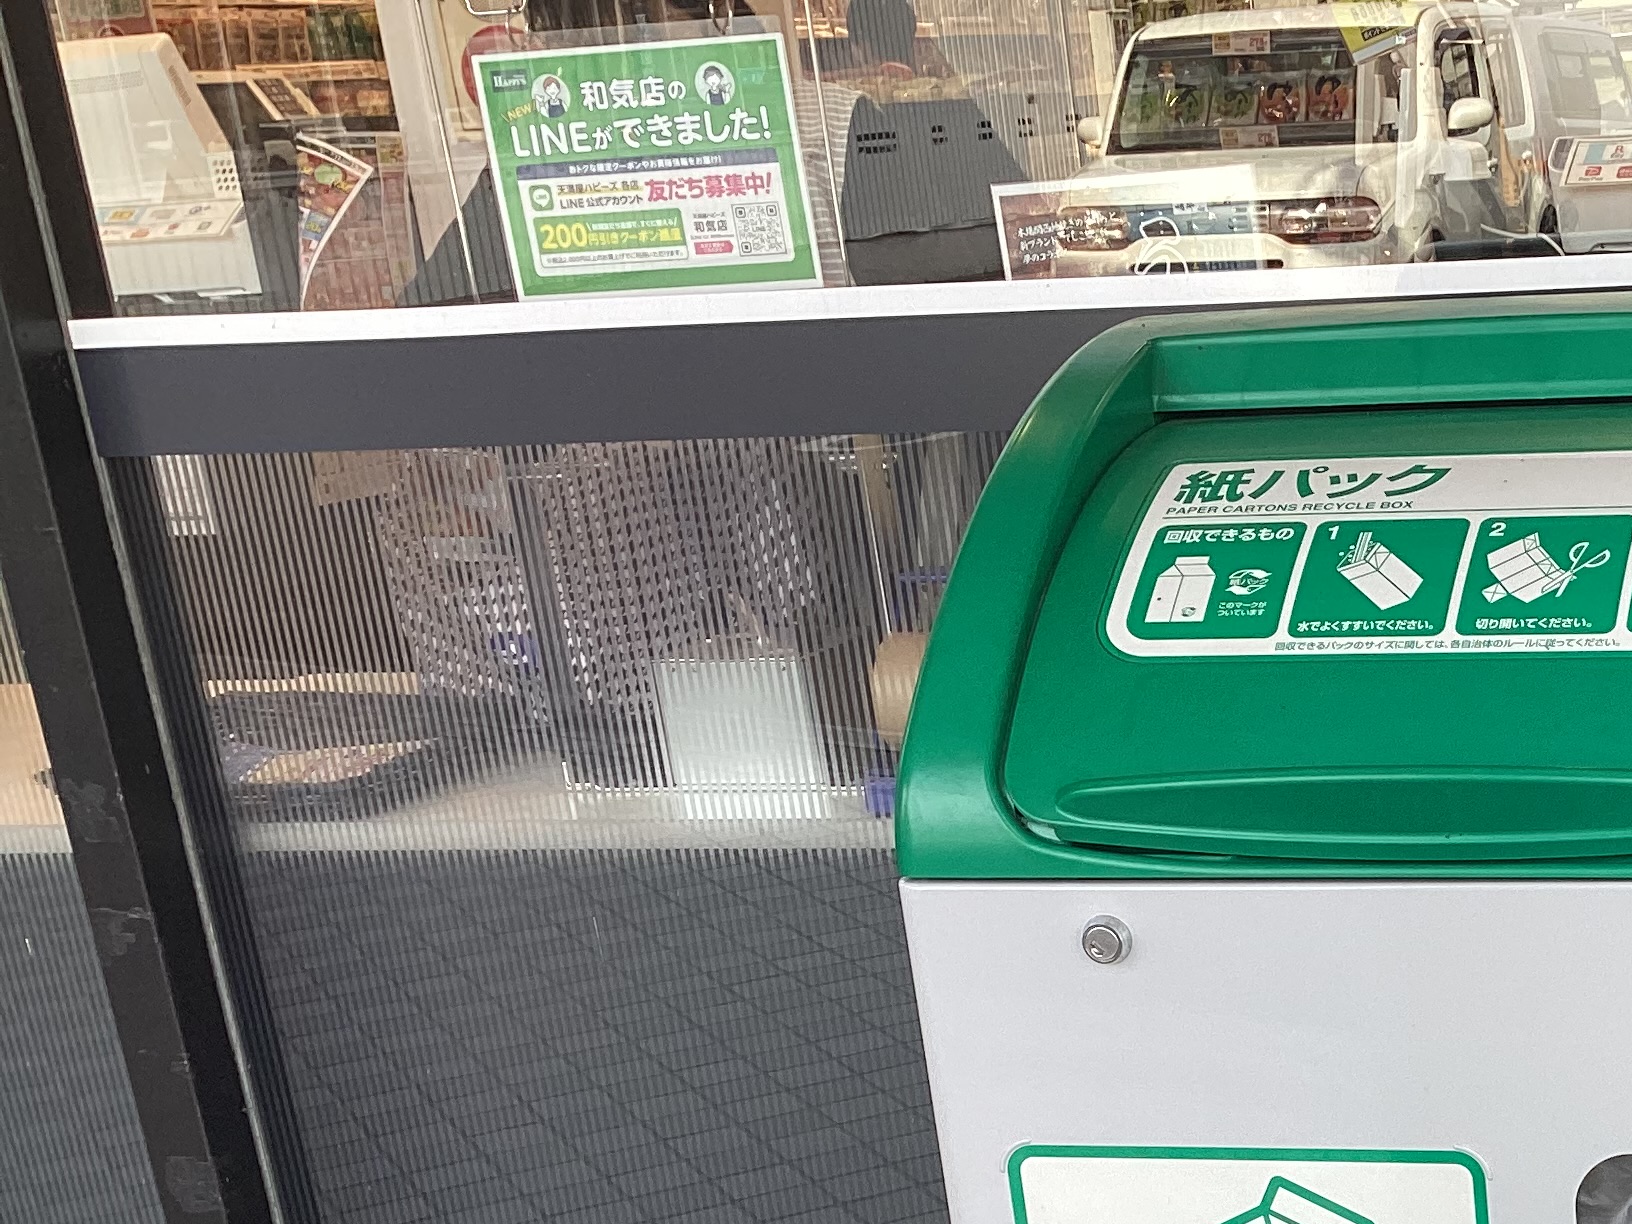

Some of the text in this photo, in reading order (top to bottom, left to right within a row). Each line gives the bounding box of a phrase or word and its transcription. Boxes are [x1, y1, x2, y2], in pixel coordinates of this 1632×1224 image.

[579, 76, 687, 112] 和気店の
[507, 102, 532, 121] NEW
[560, 195, 644, 210] LINE 公式アカウント
[694, 220, 728, 233] 和気店
[1173, 465, 1452, 504] 紙パック
[1166, 500, 1414, 515] PAPER CARTONS RECYCLE BOX
[1163, 527, 1295, 545] 回収できるもの
[1328, 525, 1340, 541] 1
[1489, 522, 1507, 537] 2
[1219, 601, 1267, 609] このマークが
[1217, 609, 1265, 617] ついています
[1475, 617, 1592, 630] 切り開いてください。
